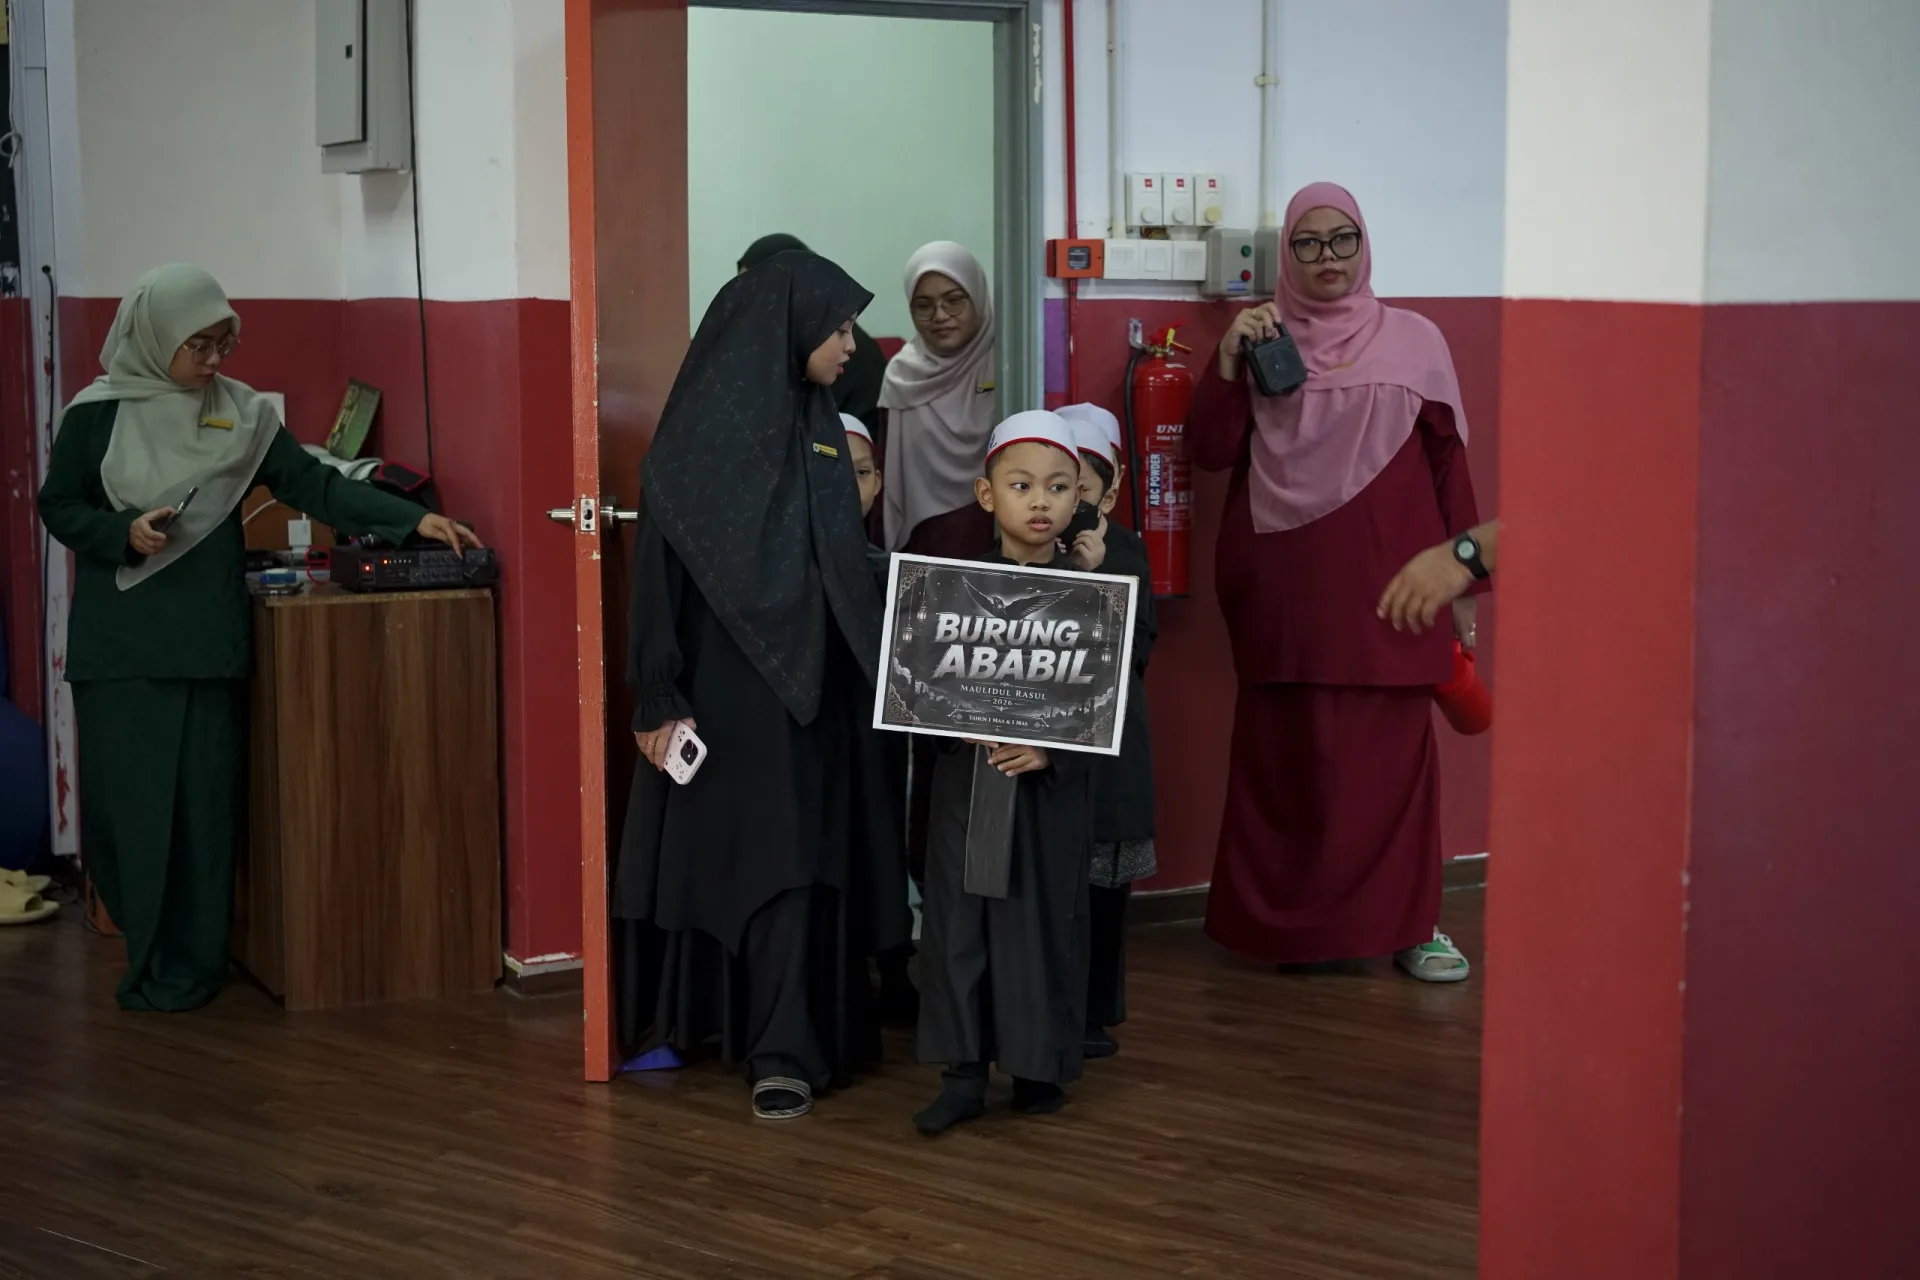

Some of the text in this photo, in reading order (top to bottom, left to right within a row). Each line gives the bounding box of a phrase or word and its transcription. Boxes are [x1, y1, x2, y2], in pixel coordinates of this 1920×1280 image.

[1150, 454, 1160, 506] ABC POWDER
[935, 612, 1083, 648] BURUNG
[931, 644, 1096, 684] ABABIL
[960, 684, 1047, 700] MAULIDUL RASUL
[992, 697, 1013, 706] 2026
